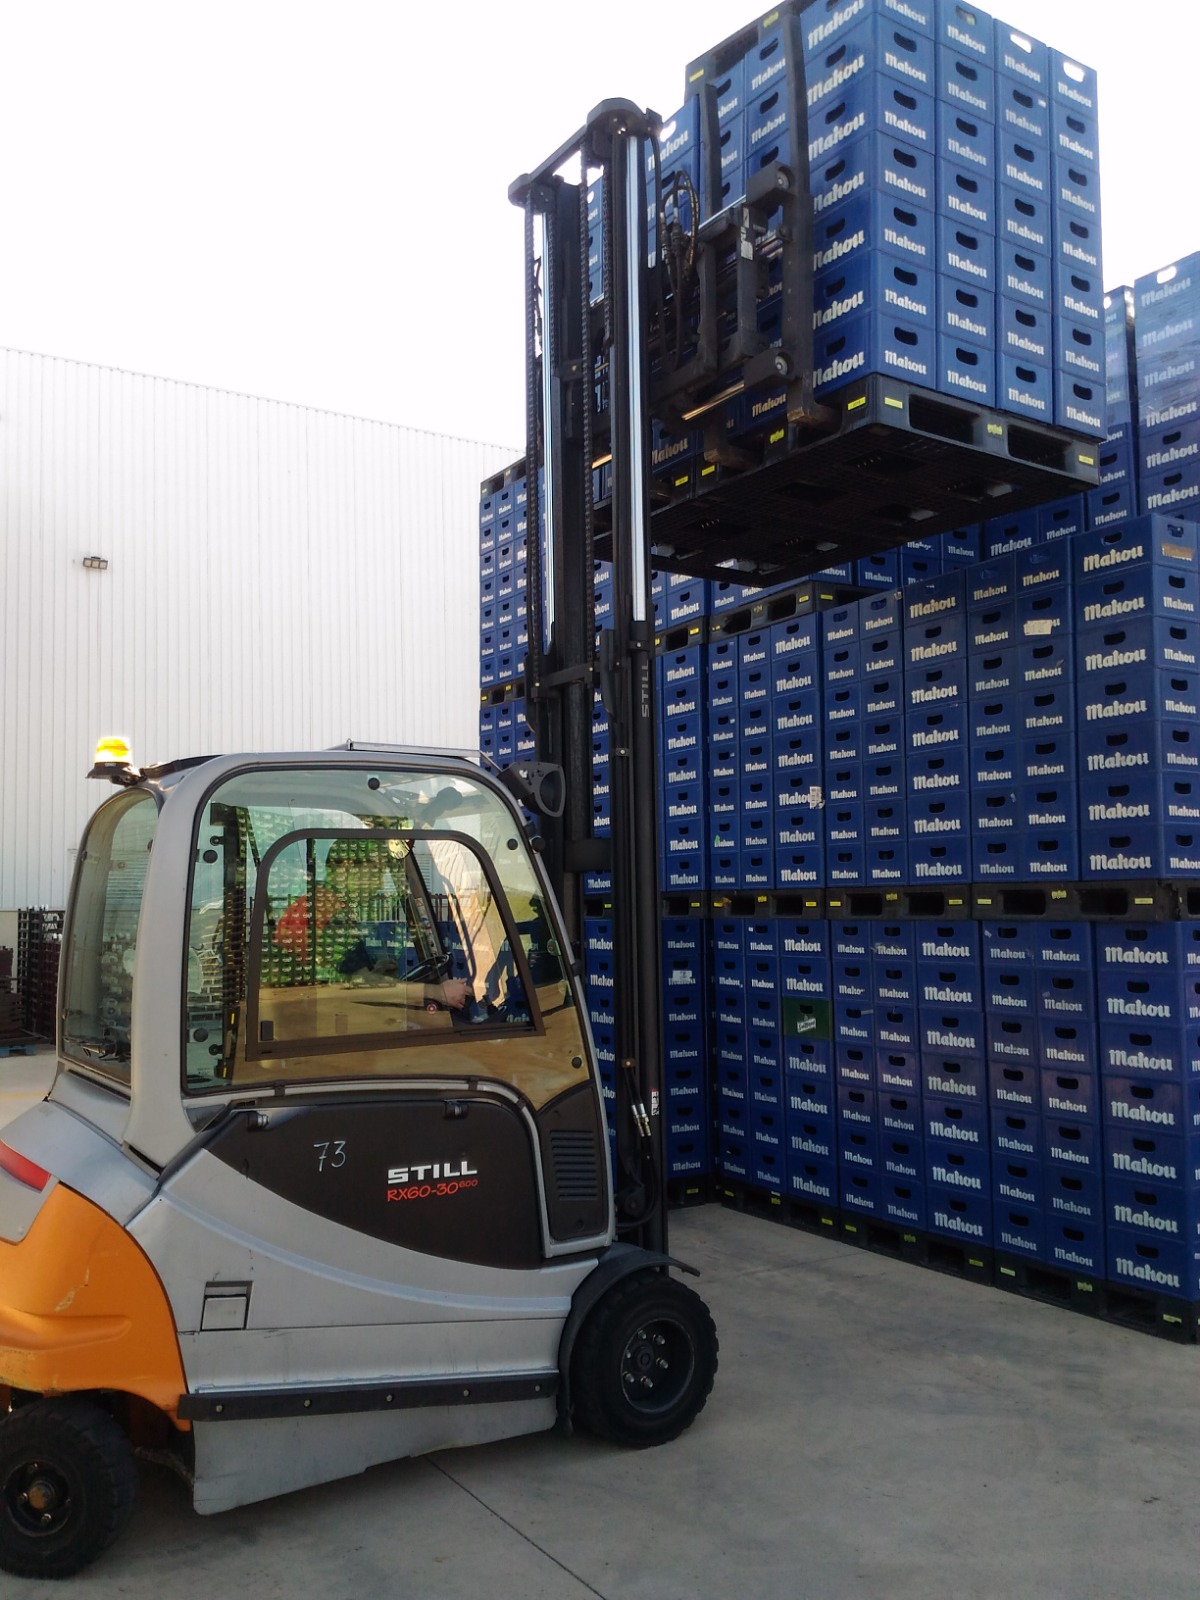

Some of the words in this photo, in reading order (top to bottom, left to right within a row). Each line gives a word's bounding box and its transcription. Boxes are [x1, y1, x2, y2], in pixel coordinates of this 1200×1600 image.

[808, 0, 864, 50] Mahou
[948, 25, 986, 54] Mahou
[885, 52, 926, 82] Mahou
[1005, 55, 1040, 82] Mahou
[807, 54, 864, 106] Mahou
[948, 82, 986, 110] Mahou
[1058, 82, 1091, 107] Mahou
[885, 111, 926, 139] Mahou
[1006, 109, 1041, 136] Mahou
[809, 112, 864, 161] Mahou
[948, 138, 986, 165] Mahou
[1059, 134, 1093, 159] Mahou
[885, 170, 926, 197] Mahou
[1007, 164, 1042, 190] Mahou
[948, 195, 986, 221] Mahou
[1062, 188, 1095, 212] Mahou
[1007, 219, 1043, 244] Mahou
[884, 229, 925, 255] Mahou
[1063, 242, 1096, 265] Mahou
[948, 253, 987, 278] Mahou
[1008, 275, 1044, 299] Mahou
[885, 289, 926, 315] Mahou
[1064, 296, 1098, 318] Mahou
[947, 312, 986, 336] Mahou
[1008, 332, 1044, 355] Mahou
[885, 350, 926, 374] Mahou
[1065, 350, 1099, 372] Mahou
[948, 370, 986, 393] Mahou
[1008, 388, 1045, 410] Mahou
[1067, 406, 1100, 427] Mahou
[1146, 402, 1197, 427] Mahou
[1146, 443, 1199, 468] Mahou
[1147, 484, 1199, 510] Mahou
[1095, 510, 1127, 525] Mahou
[1083, 545, 1144, 572] Mahou
[1023, 569, 1060, 587] Mahou
[974, 584, 1007, 600] Mahou
[910, 596, 956, 619] Mahou
[1084, 596, 1145, 621] Mahou
[1163, 597, 1194, 611] Mahou
[866, 617, 893, 630] Mahou
[828, 629, 853, 641] Mahou
[975, 629, 1009, 646] Mahou
[776, 636, 810, 654] Mahou
[911, 640, 957, 662] Mahou
[1086, 647, 1146, 671] Mahou
[1164, 648, 1195, 663] Mahou
[667, 667, 694, 681] Mahou
[829, 669, 854, 680] Mahou
[1025, 668, 1061, 681] Mahou
[641, 659, 649, 718] STILL
[776, 676, 811, 692] Mahou
[976, 679, 1009, 691] Mahou
[911, 686, 958, 703] Mahou
[667, 702, 695, 716] Mahou
[829, 709, 855, 720] Mahou
[867, 701, 895, 712] Mahou
[1086, 700, 1147, 720] Mahou
[1165, 700, 1196, 714] Mahou
[778, 715, 812, 729] Mahou
[976, 725, 1010, 736] Mahou
[1026, 716, 1063, 728] Mahou
[668, 736, 696, 749] Mahou
[912, 730, 959, 746] Mahou
[830, 750, 856, 759] Mahou
[869, 744, 896, 754] Mahou
[778, 753, 813, 767] Mahou
[1087, 752, 1149, 770] Mahou
[1167, 753, 1200, 765] Mahou
[669, 770, 696, 783] Mahou
[978, 771, 1011, 781] Mahou
[1027, 765, 1064, 776] Mahou
[870, 785, 897, 795] Mahou
[913, 774, 959, 789] Mahou
[831, 790, 856, 799] Mahou
[669, 804, 697, 816] Mahou
[1088, 805, 1150, 820] Mahou
[1169, 805, 1200, 817] Mahou
[914, 818, 961, 833] Mahou
[979, 817, 1013, 828] Mahou
[1029, 814, 1065, 824] Mahou
[780, 830, 815, 843] Mahou
[831, 830, 857, 839] Mahou
[871, 827, 899, 836] Mahou
[670, 839, 698, 851] Mahou
[915, 862, 962, 877] Mahou
[980, 864, 1014, 873] Mahou
[1030, 862, 1067, 872] Mahou
[1090, 855, 1152, 870] Mahou
[670, 874, 698, 884] Mahou
[781, 869, 816, 881] Mahou
[832, 870, 858, 879] Mahou
[872, 869, 900, 878] Mahou
[784, 939, 821, 951] Mahou
[838, 944, 864, 953] Mahou
[922, 942, 970, 957] Mahou
[1042, 950, 1080, 961] Mahou
[1105, 947, 1169, 964] Mahou
[786, 978, 823, 992] Mahou
[924, 987, 972, 1002] Mahou
[1044, 999, 1082, 1011] Mahou
[1107, 998, 1170, 1017] Mahou
[840, 1026, 867, 1037] Mahou
[927, 1031, 975, 1048] Mahou
[1046, 1047, 1085, 1063] Mahou
[1109, 1050, 1173, 1071] Mahou
[789, 1057, 826, 1073] Mahou
[842, 1068, 869, 1080] Mahou
[928, 1076, 976, 1096] Mahou
[791, 1096, 828, 1114] Mahou
[1049, 1098, 1087, 1112] Mahou
[1111, 1101, 1175, 1125] Mahou
[930, 1121, 978, 1142] Mahou
[792, 1136, 829, 1155] Mahou
[313, 1140, 347, 1171] 73
[845, 1151, 872, 1165] Mahou
[1051, 1147, 1089, 1164] Mahou
[387, 1161, 478, 1184] STILL
[1113, 1153, 1176, 1179] Mahou
[793, 1176, 830, 1197] Mahou
[932, 1167, 981, 1189] Mahou
[934, 1212, 983, 1236] Mahou
[1114, 1205, 1178, 1233] Mahou
[1116, 1258, 1180, 1287] Mahou
